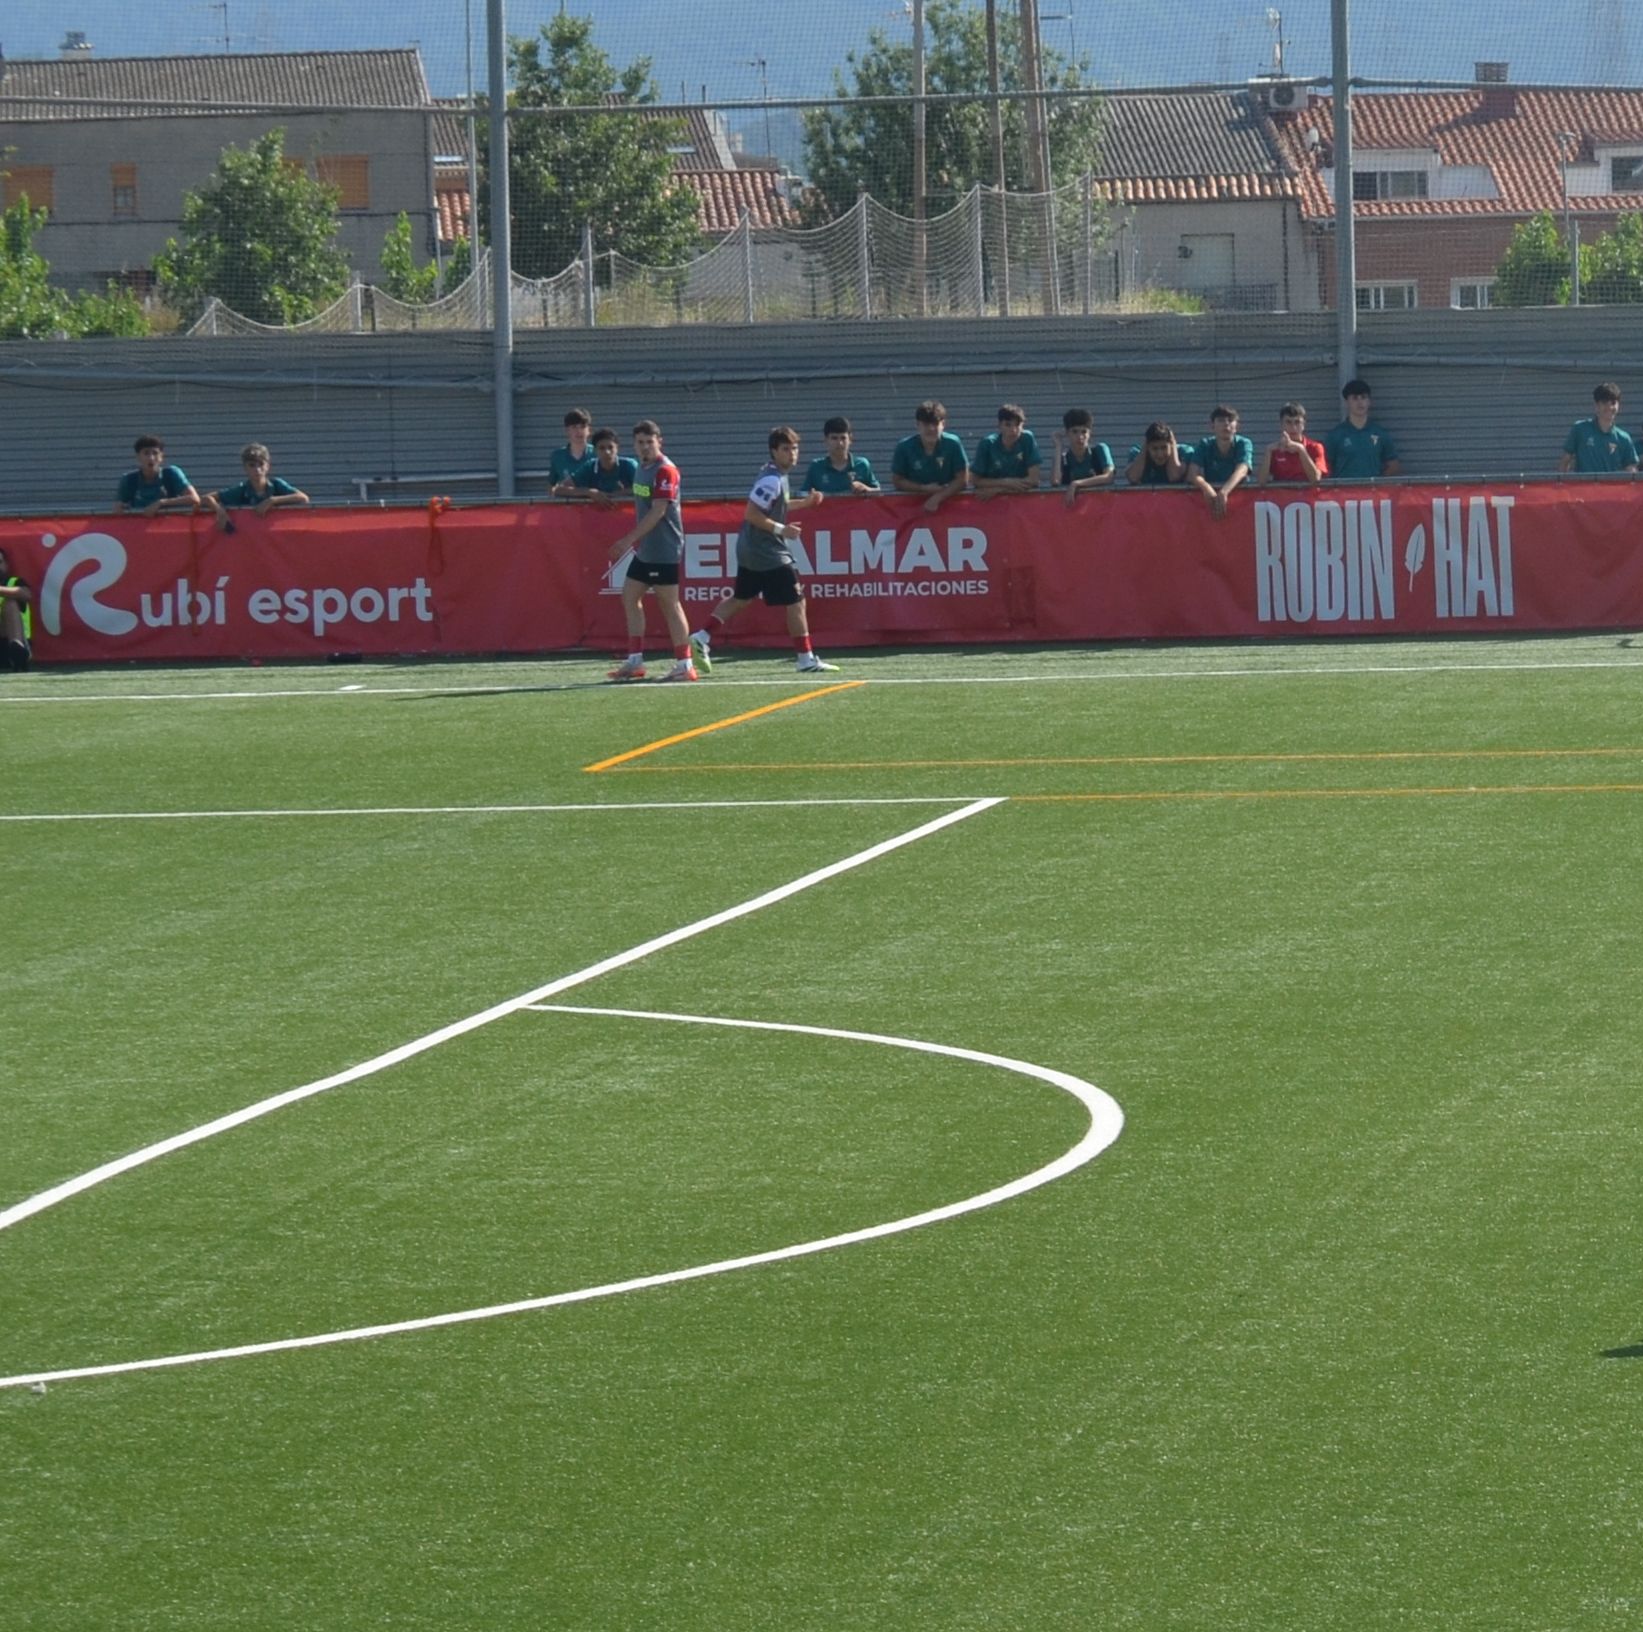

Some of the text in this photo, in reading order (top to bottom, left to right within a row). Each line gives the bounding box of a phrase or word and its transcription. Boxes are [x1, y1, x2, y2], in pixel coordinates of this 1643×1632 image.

[40, 533, 434, 637] Rubí esport
[811, 580, 989, 598] REHABILITACIONES
[1254, 496, 1515, 622] ROBIN HAT
